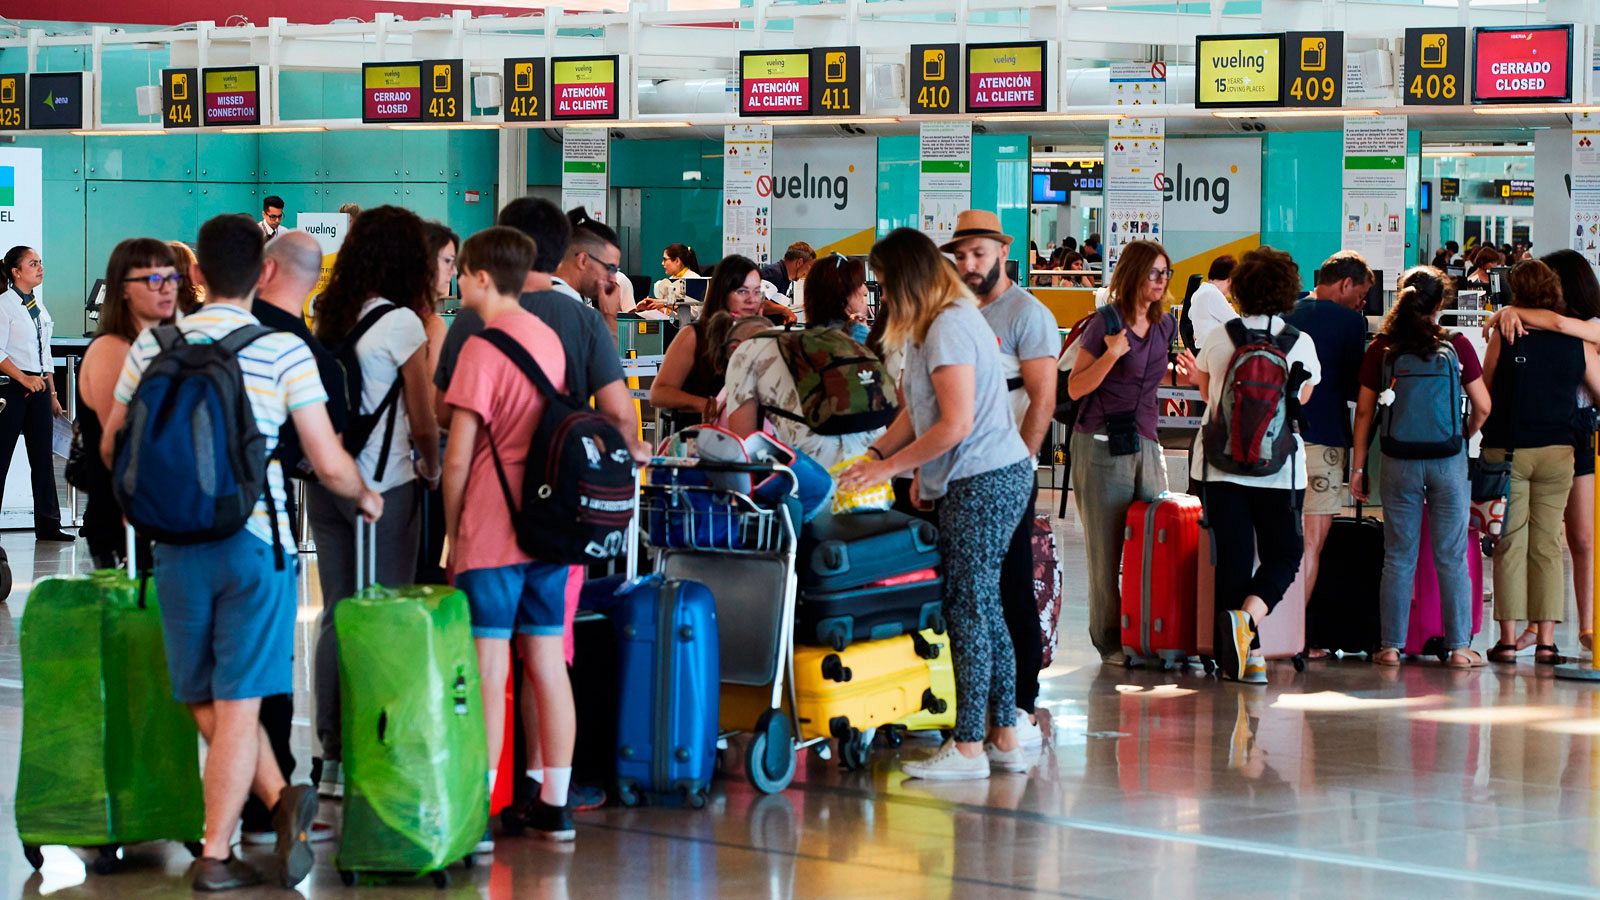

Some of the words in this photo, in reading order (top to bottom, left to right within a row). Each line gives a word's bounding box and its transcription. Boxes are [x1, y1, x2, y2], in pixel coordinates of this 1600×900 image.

[993, 54, 1016, 65] vueling
[1212, 49, 1264, 73] vueling
[1491, 61, 1551, 75] CERRADO
[751, 80, 800, 93] ATENCIÓN
[979, 74, 1031, 88] ATENCIÓN
[1215, 78, 1227, 92] 15
[1227, 77, 1244, 85] YEARS
[1410, 74, 1456, 99] 408
[1495, 78, 1545, 91] CLOSED
[561, 85, 606, 98] ATENCIÓN
[1246, 85, 1265, 93] PLACES
[1290, 77, 1335, 101] 409
[217, 95, 244, 105] MISSED
[374, 91, 411, 102] CERRADO
[748, 96, 761, 107] AL
[763, 95, 803, 106] CLIENTE
[821, 88, 850, 110] 411
[917, 86, 950, 108] 410
[976, 92, 989, 102] AL
[991, 90, 1034, 102] CLIENTE
[208, 107, 254, 117] CONNECTION
[377, 104, 408, 113] CLOSED
[428, 97, 456, 117] 413
[510, 96, 538, 117] 412
[559, 101, 571, 111] AL
[572, 100, 608, 111] CLIENTE
[169, 104, 192, 123] 414
[772, 162, 848, 211] ueling
[1163, 162, 1230, 214] eling
[0, 211, 15, 222] EL
[305, 222, 337, 238] vueling
